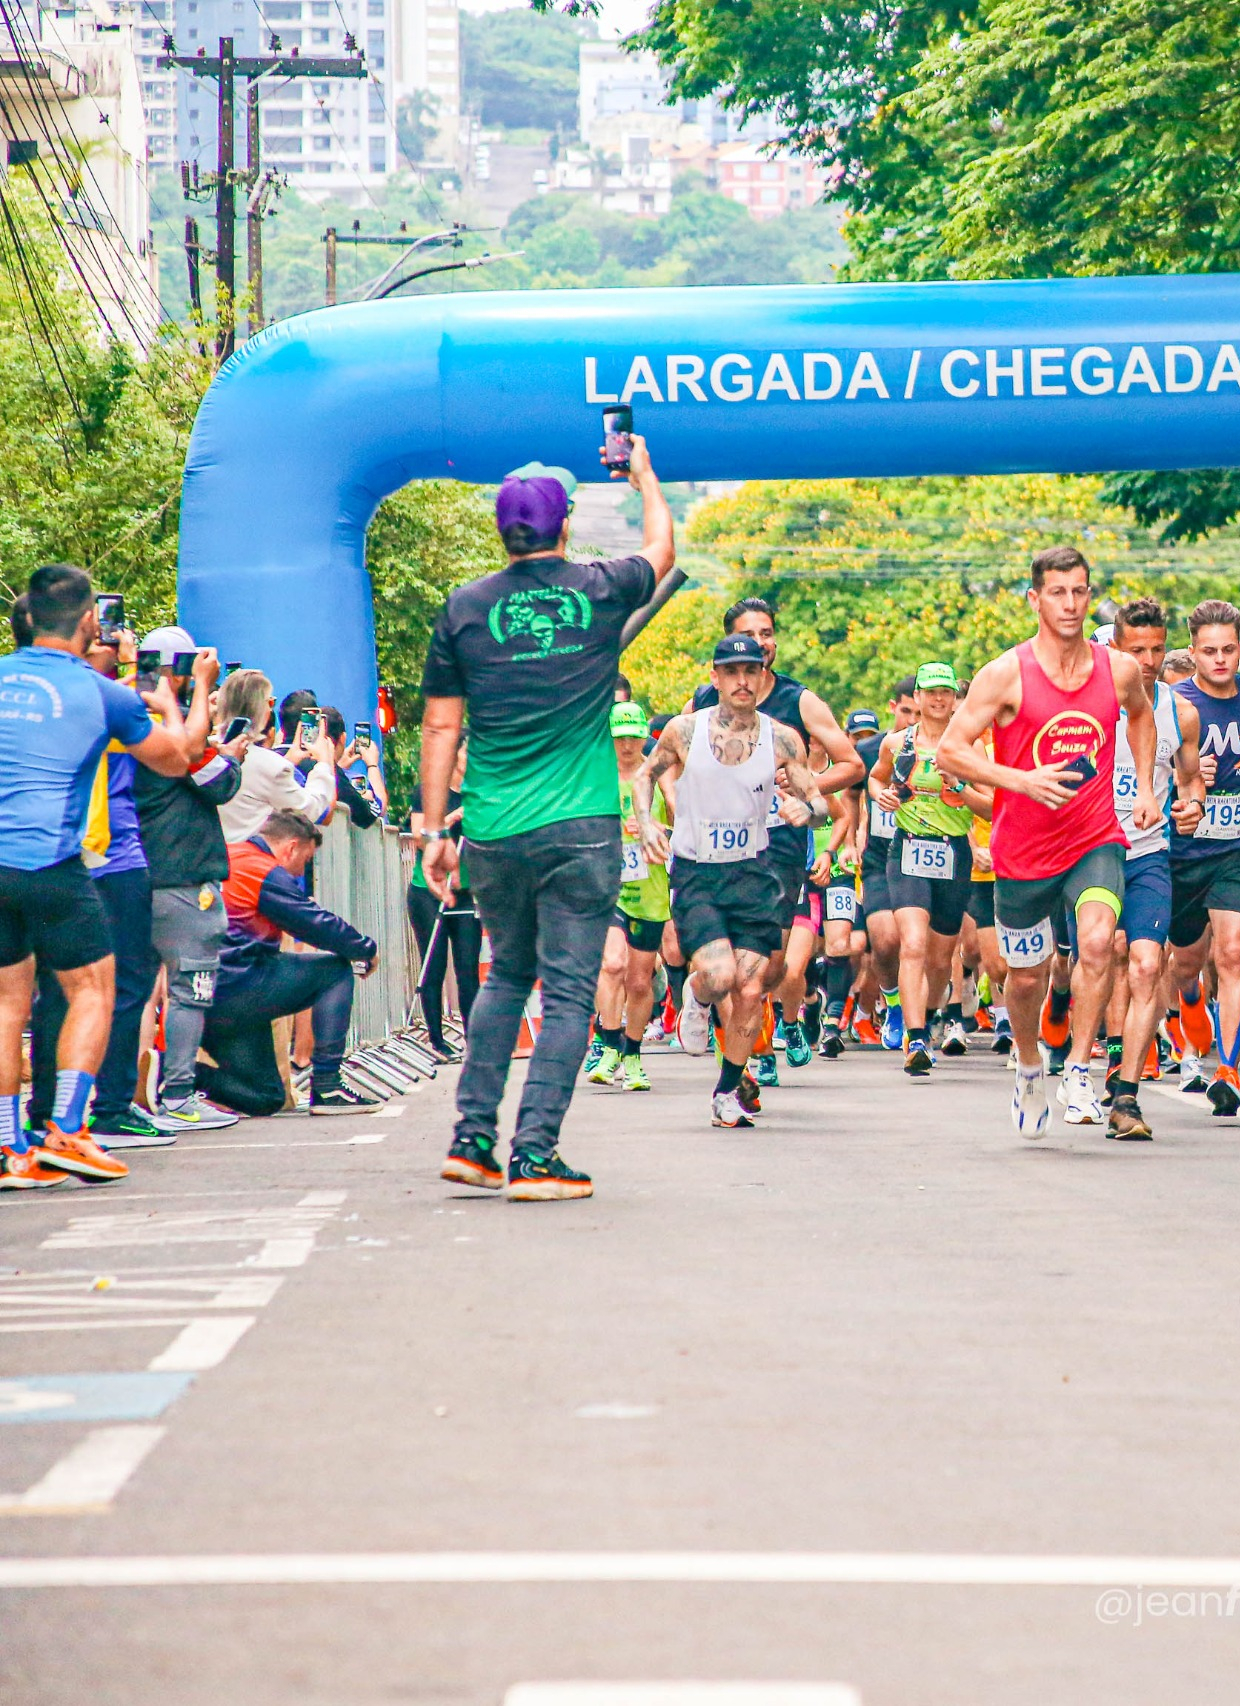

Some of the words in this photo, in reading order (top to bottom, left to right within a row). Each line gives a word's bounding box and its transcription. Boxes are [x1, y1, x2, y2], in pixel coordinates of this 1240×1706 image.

[583, 350, 890, 405] LARGADA
[903, 350, 921, 400] /
[708, 828, 749, 850] 190
[911, 846, 946, 867] 155
[834, 895, 852, 911] 88
[1001, 932, 1044, 956] 149
